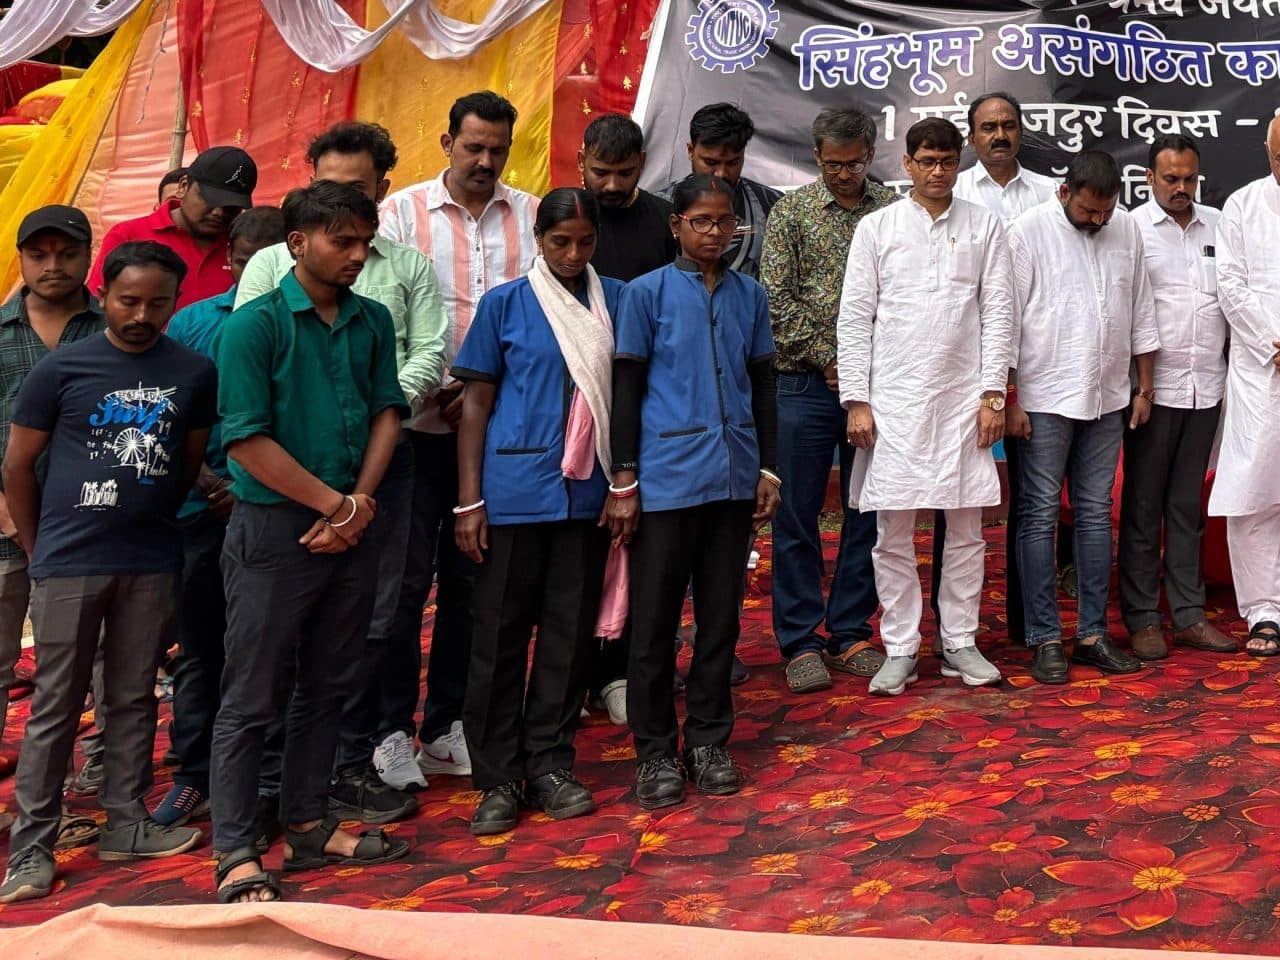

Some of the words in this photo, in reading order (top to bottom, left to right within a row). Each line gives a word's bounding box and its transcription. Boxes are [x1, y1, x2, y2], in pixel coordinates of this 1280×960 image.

[716, 9, 751, 47] INTUC
[791, 22, 983, 96] सिंहभूम
[992, 14, 1215, 87] असंगठित
[881, 105, 897, 141] 1
[1020, 103, 1107, 152] जदुर
[1112, 95, 1223, 144] दिवस
[89, 397, 169, 433] Surf
